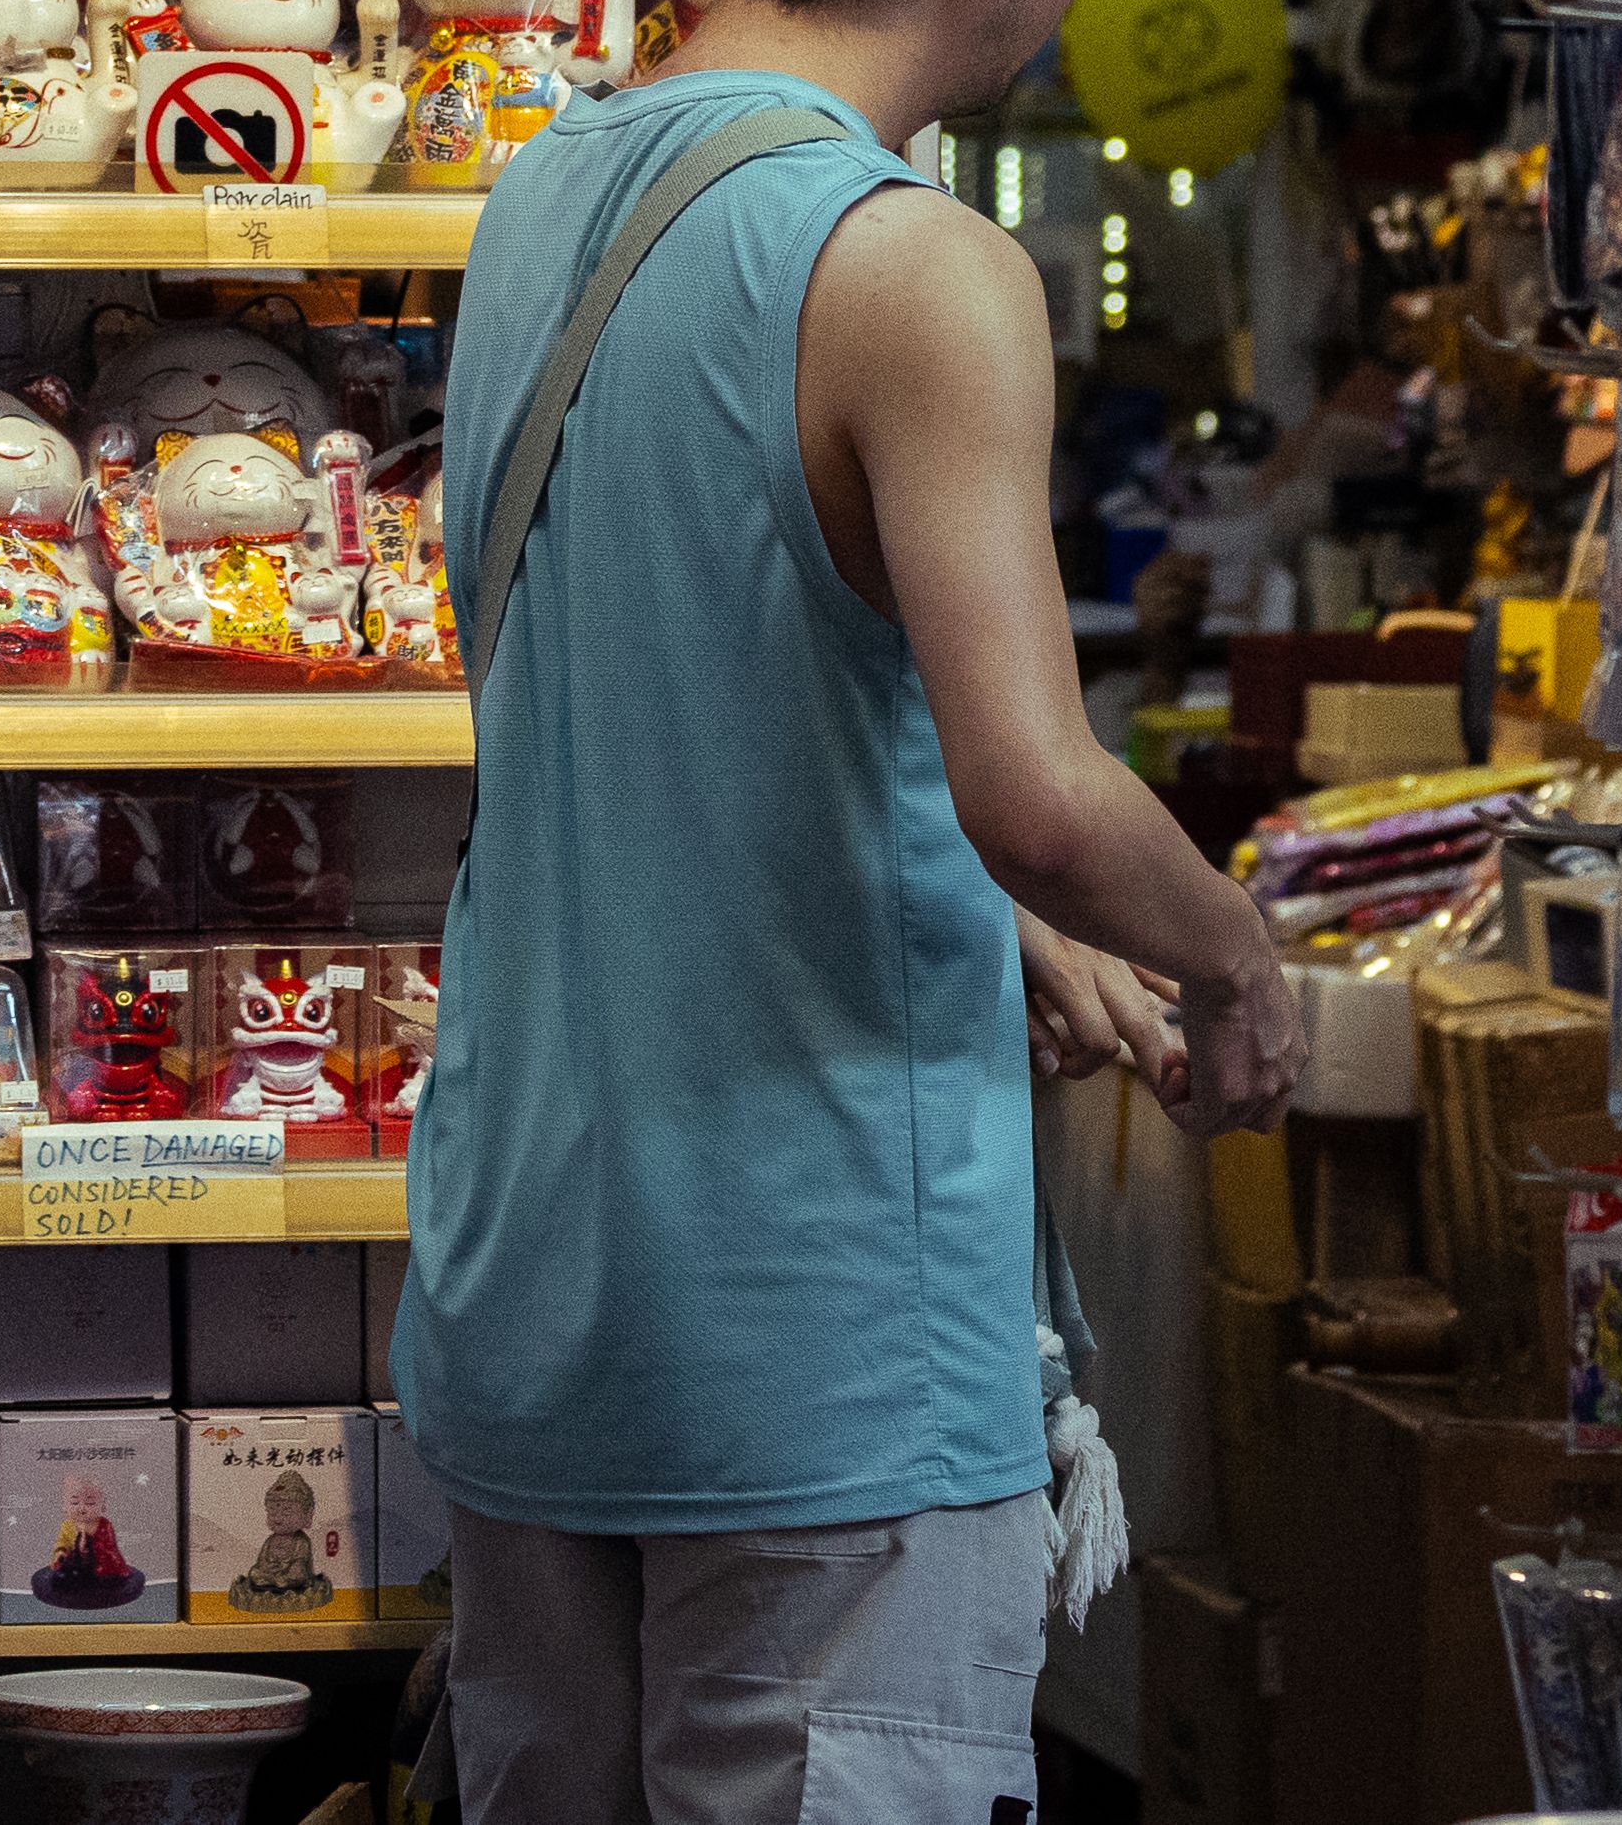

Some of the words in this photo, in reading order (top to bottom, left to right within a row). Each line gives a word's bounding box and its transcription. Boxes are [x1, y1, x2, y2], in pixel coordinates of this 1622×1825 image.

[213, 185, 313, 211] Porcelain
[37, 1135, 131, 1169] ONCE
[141, 1134, 282, 1166] DAMAGED
[28, 1175, 209, 1206] CONSIDERED
[34, 1208, 133, 1237] SOLD!
